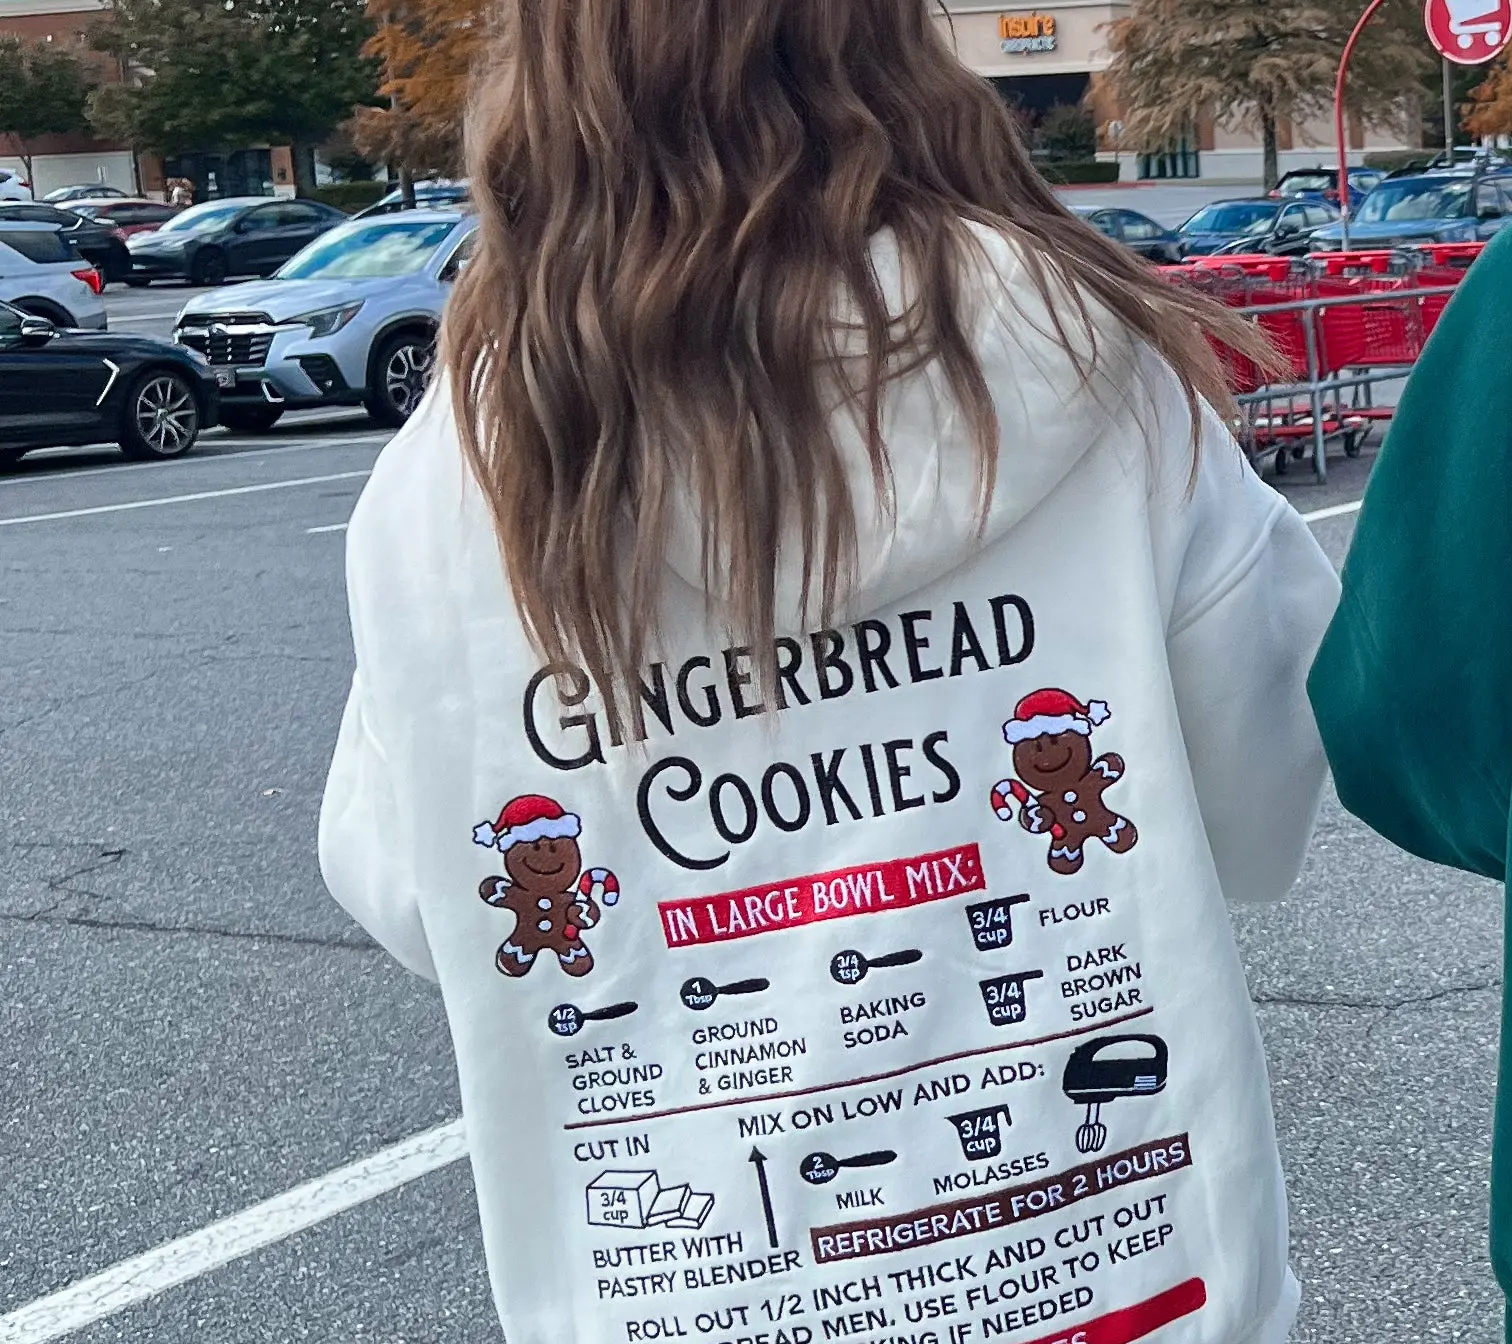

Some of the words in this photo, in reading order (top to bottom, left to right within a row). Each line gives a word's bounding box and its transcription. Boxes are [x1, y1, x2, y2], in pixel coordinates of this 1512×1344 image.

[636, 730, 961, 870] COOKIES
[665, 905, 700, 943] IN
[706, 886, 802, 937] LARGE
[812, 869, 895, 914] BOWL
[904, 852, 978, 899] MIX:
[973, 910, 1009, 930] 3/4
[1038, 897, 1111, 927] FLOUR
[977, 928, 1008, 944] cup
[836, 954, 859, 969] 3/4
[1066, 942, 1128, 972] DARK
[691, 980, 702, 994] 1
[838, 968, 861, 981] tsp
[1061, 962, 1142, 999] BROWN
[985, 981, 1022, 1005] 3/4
[1070, 988, 1143, 1022] SUGAR
[552, 1007, 576, 1021] 1/2
[840, 991, 926, 1025] BAKING
[991, 1004, 1022, 1020] cup
[555, 1022, 578, 1034] tsp
[692, 1017, 778, 1045] GROUND
[843, 1019, 909, 1049] SODA
[565, 1045, 616, 1069] SALT
[621, 1043, 637, 1060] &
[694, 1037, 807, 1071] CINNAMON
[572, 1063, 664, 1091] GROUND
[698, 1078, 713, 1095] &
[717, 1065, 794, 1091] GINGER
[578, 1089, 656, 1115] CLOVES
[737, 1111, 786, 1139] MIX
[791, 1106, 835, 1131] ON
[841, 1088, 904, 1121] LOW
[913, 1074, 972, 1106] AND
[980, 1060, 1046, 1090] ADD:
[960, 1116, 997, 1138] 3/4
[573, 1138, 619, 1162] CUT
[626, 1133, 651, 1157] IN
[966, 1137, 998, 1155] cup
[805, 1169, 835, 1181] Tbsp
[812, 1156, 824, 1169] 2
[932, 1151, 1051, 1196] MOLASSES
[600, 1189, 627, 1207] 3/4
[816, 1201, 1002, 1259] REFRIGERATE
[1010, 1183, 1065, 1219] FOR
[1071, 1174, 1090, 1197] 2
[1096, 1140, 1186, 1189] HOURS
[836, 1187, 885, 1210] MILK
[602, 1209, 629, 1224] cup
[592, 1240, 678, 1269] BUTTER
[681, 1231, 744, 1258] WITH
[597, 1270, 678, 1299] PASTRY
[683, 1249, 804, 1290] BLENDER
[626, 1315, 688, 1343] ROLL
[694, 1305, 749, 1333] OUT
[760, 1293, 805, 1322] 1/2
[813, 1275, 883, 1312] INCH
[888, 1255, 978, 1293] THICK
[984, 1237, 1046, 1275] AND
[1054, 1214, 1106, 1249] CUT
[1113, 1193, 1168, 1229] OUT
[822, 1307, 896, 1340] MEN.
[903, 1294, 959, 1324] USE
[965, 1265, 1060, 1312] FLOUR
[1062, 1251, 1100, 1279] TO
[1107, 1223, 1174, 1265] KEEP
[981, 1285, 1095, 1339] NEEDED
